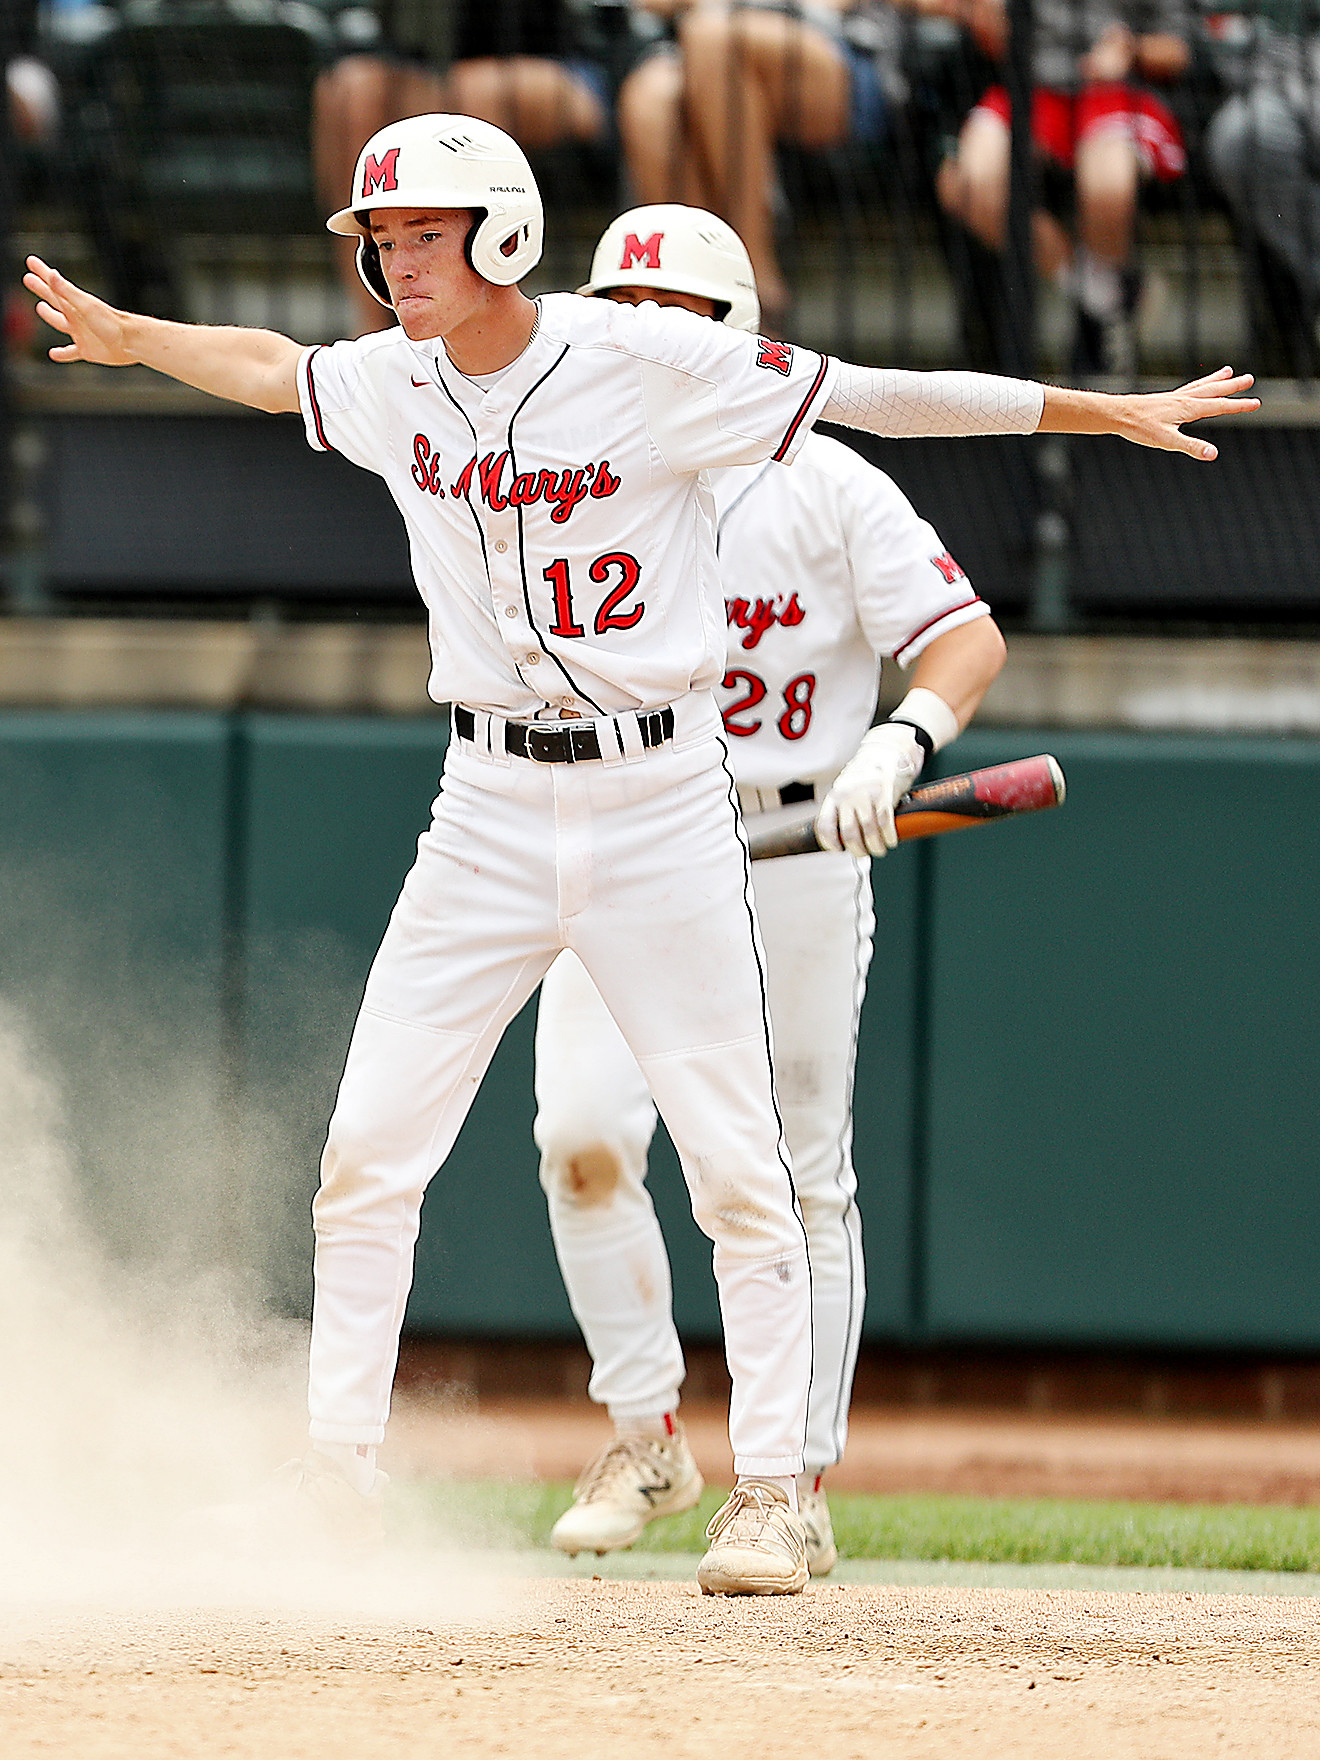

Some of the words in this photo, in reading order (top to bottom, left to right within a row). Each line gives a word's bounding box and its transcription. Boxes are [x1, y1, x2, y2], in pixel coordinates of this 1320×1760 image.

[362, 147, 401, 198] M
[619, 232, 664, 270] M
[756, 338, 794, 377] M
[412, 432, 446, 500] St.
[450, 449, 622, 524] Mary's
[929, 551, 966, 584] M
[543, 551, 646, 639] 12
[725, 592, 806, 650] ry's
[722, 670, 816, 741] 28
